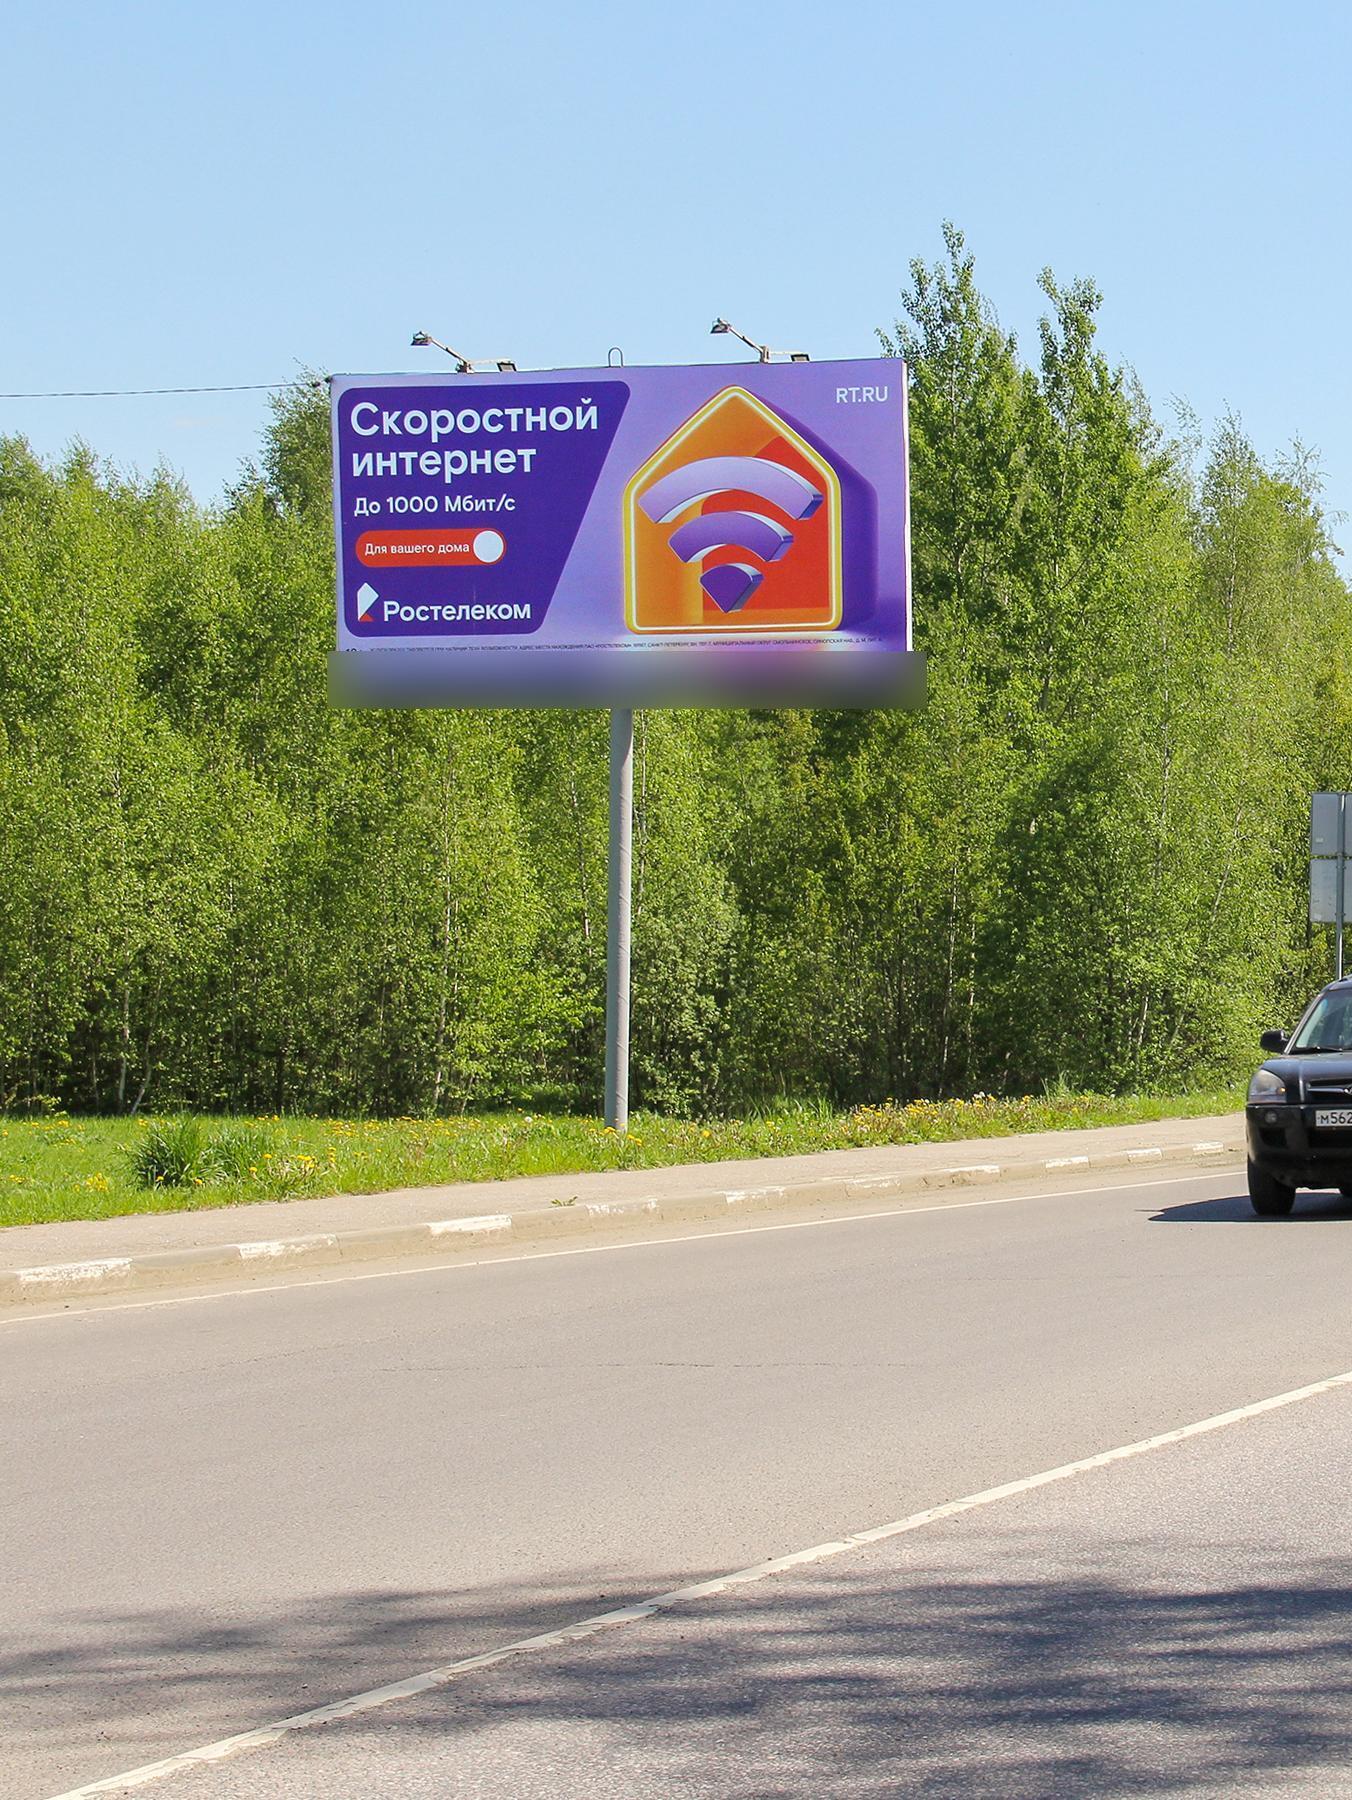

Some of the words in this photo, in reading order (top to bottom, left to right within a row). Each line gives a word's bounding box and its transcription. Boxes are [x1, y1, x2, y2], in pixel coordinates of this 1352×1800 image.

[836, 386, 888, 403] RT.RU
[350, 397, 598, 443] Скоростной
[352, 448, 537, 483] интернет
[354, 497, 381, 517] До
[386, 495, 438, 513] 1000
[444, 493, 516, 512] Мбит/с
[365, 543, 387, 556] Для
[391, 544, 435, 554] вашего
[438, 543, 470, 554] дома
[383, 600, 532, 622] Ростелеком
